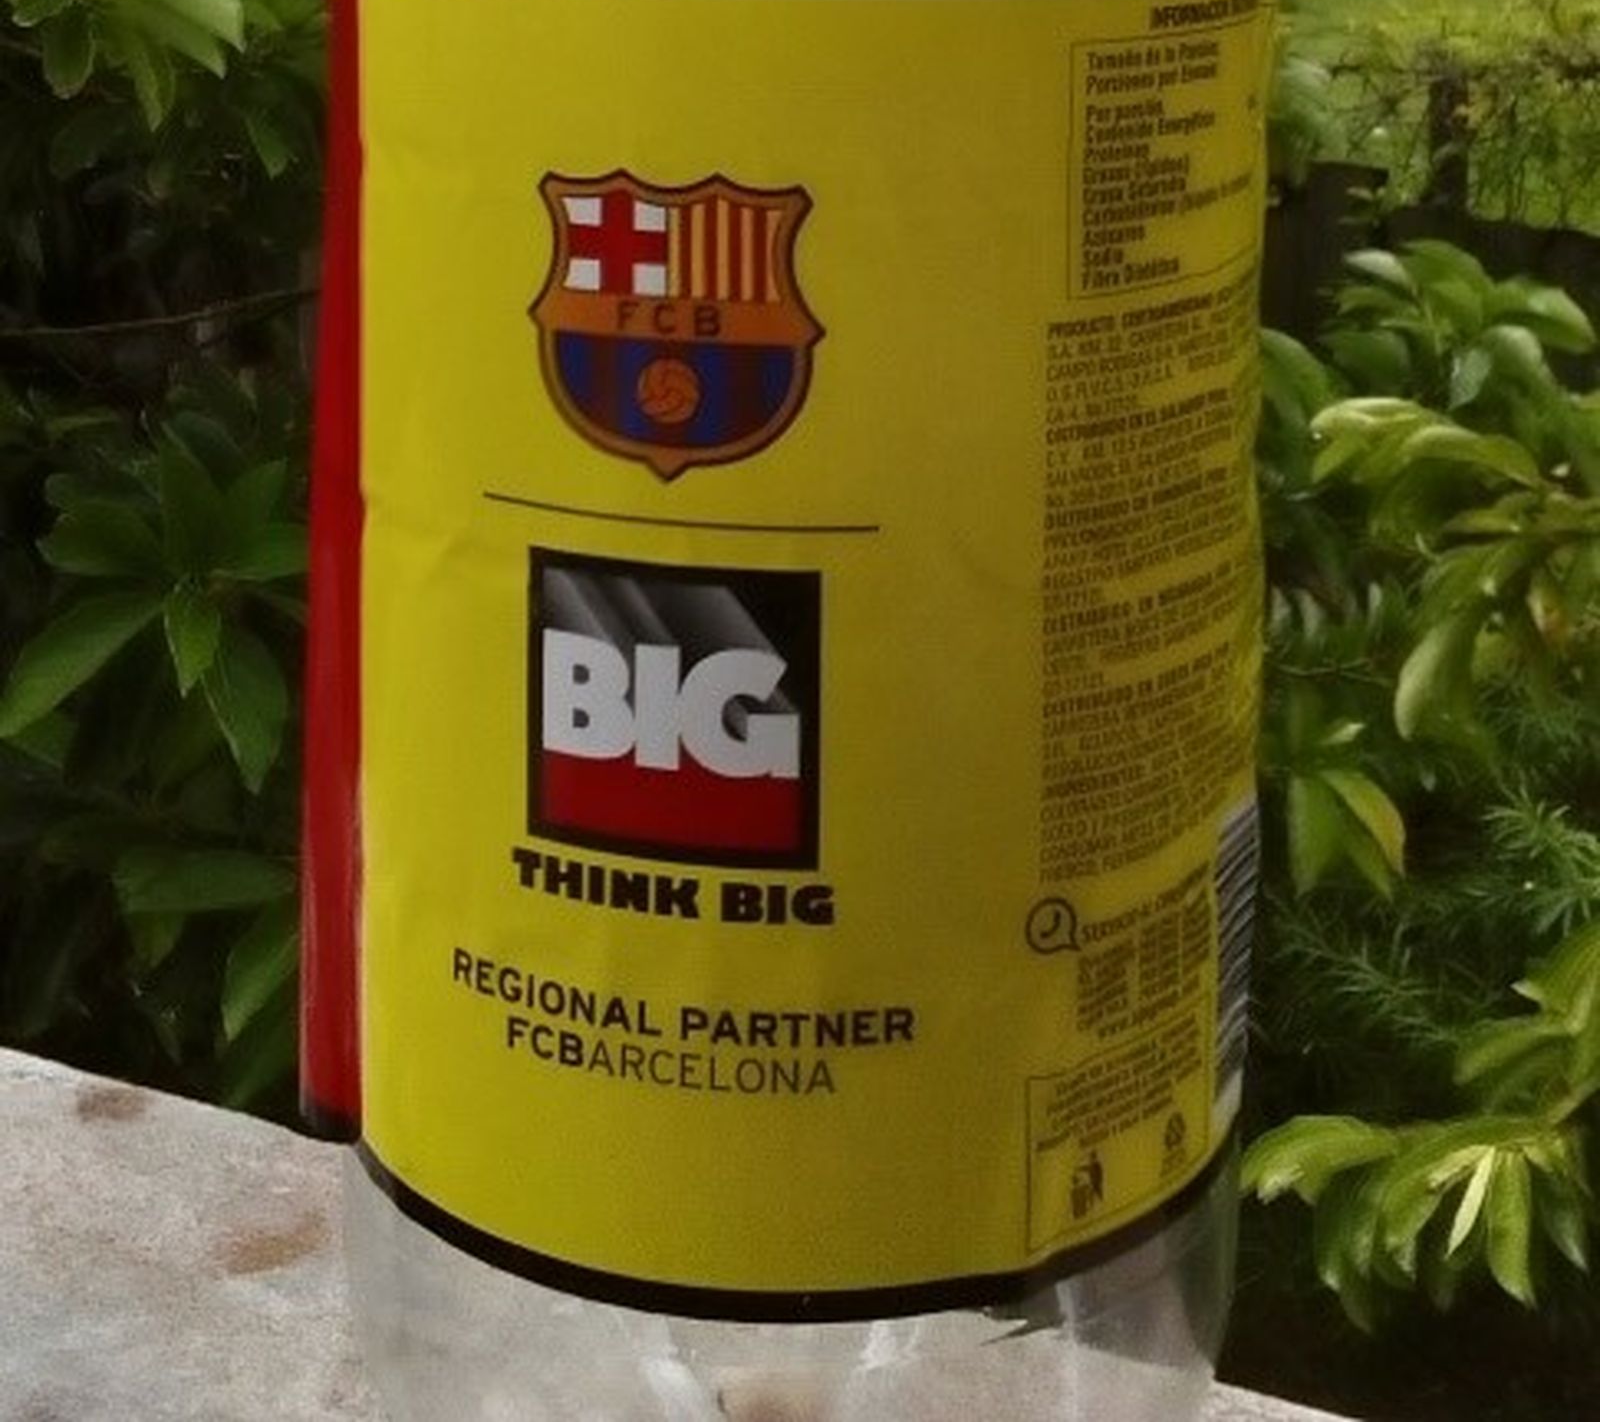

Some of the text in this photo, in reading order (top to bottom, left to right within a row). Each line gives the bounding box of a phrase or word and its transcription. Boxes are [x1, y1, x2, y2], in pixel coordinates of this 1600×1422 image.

[542, 628, 800, 780] BIG
[512, 847, 836, 925] THINK BIG
[453, 948, 915, 1048] REGIONAL PARTNER
[507, 1016, 835, 1094] FCBARCELONA
